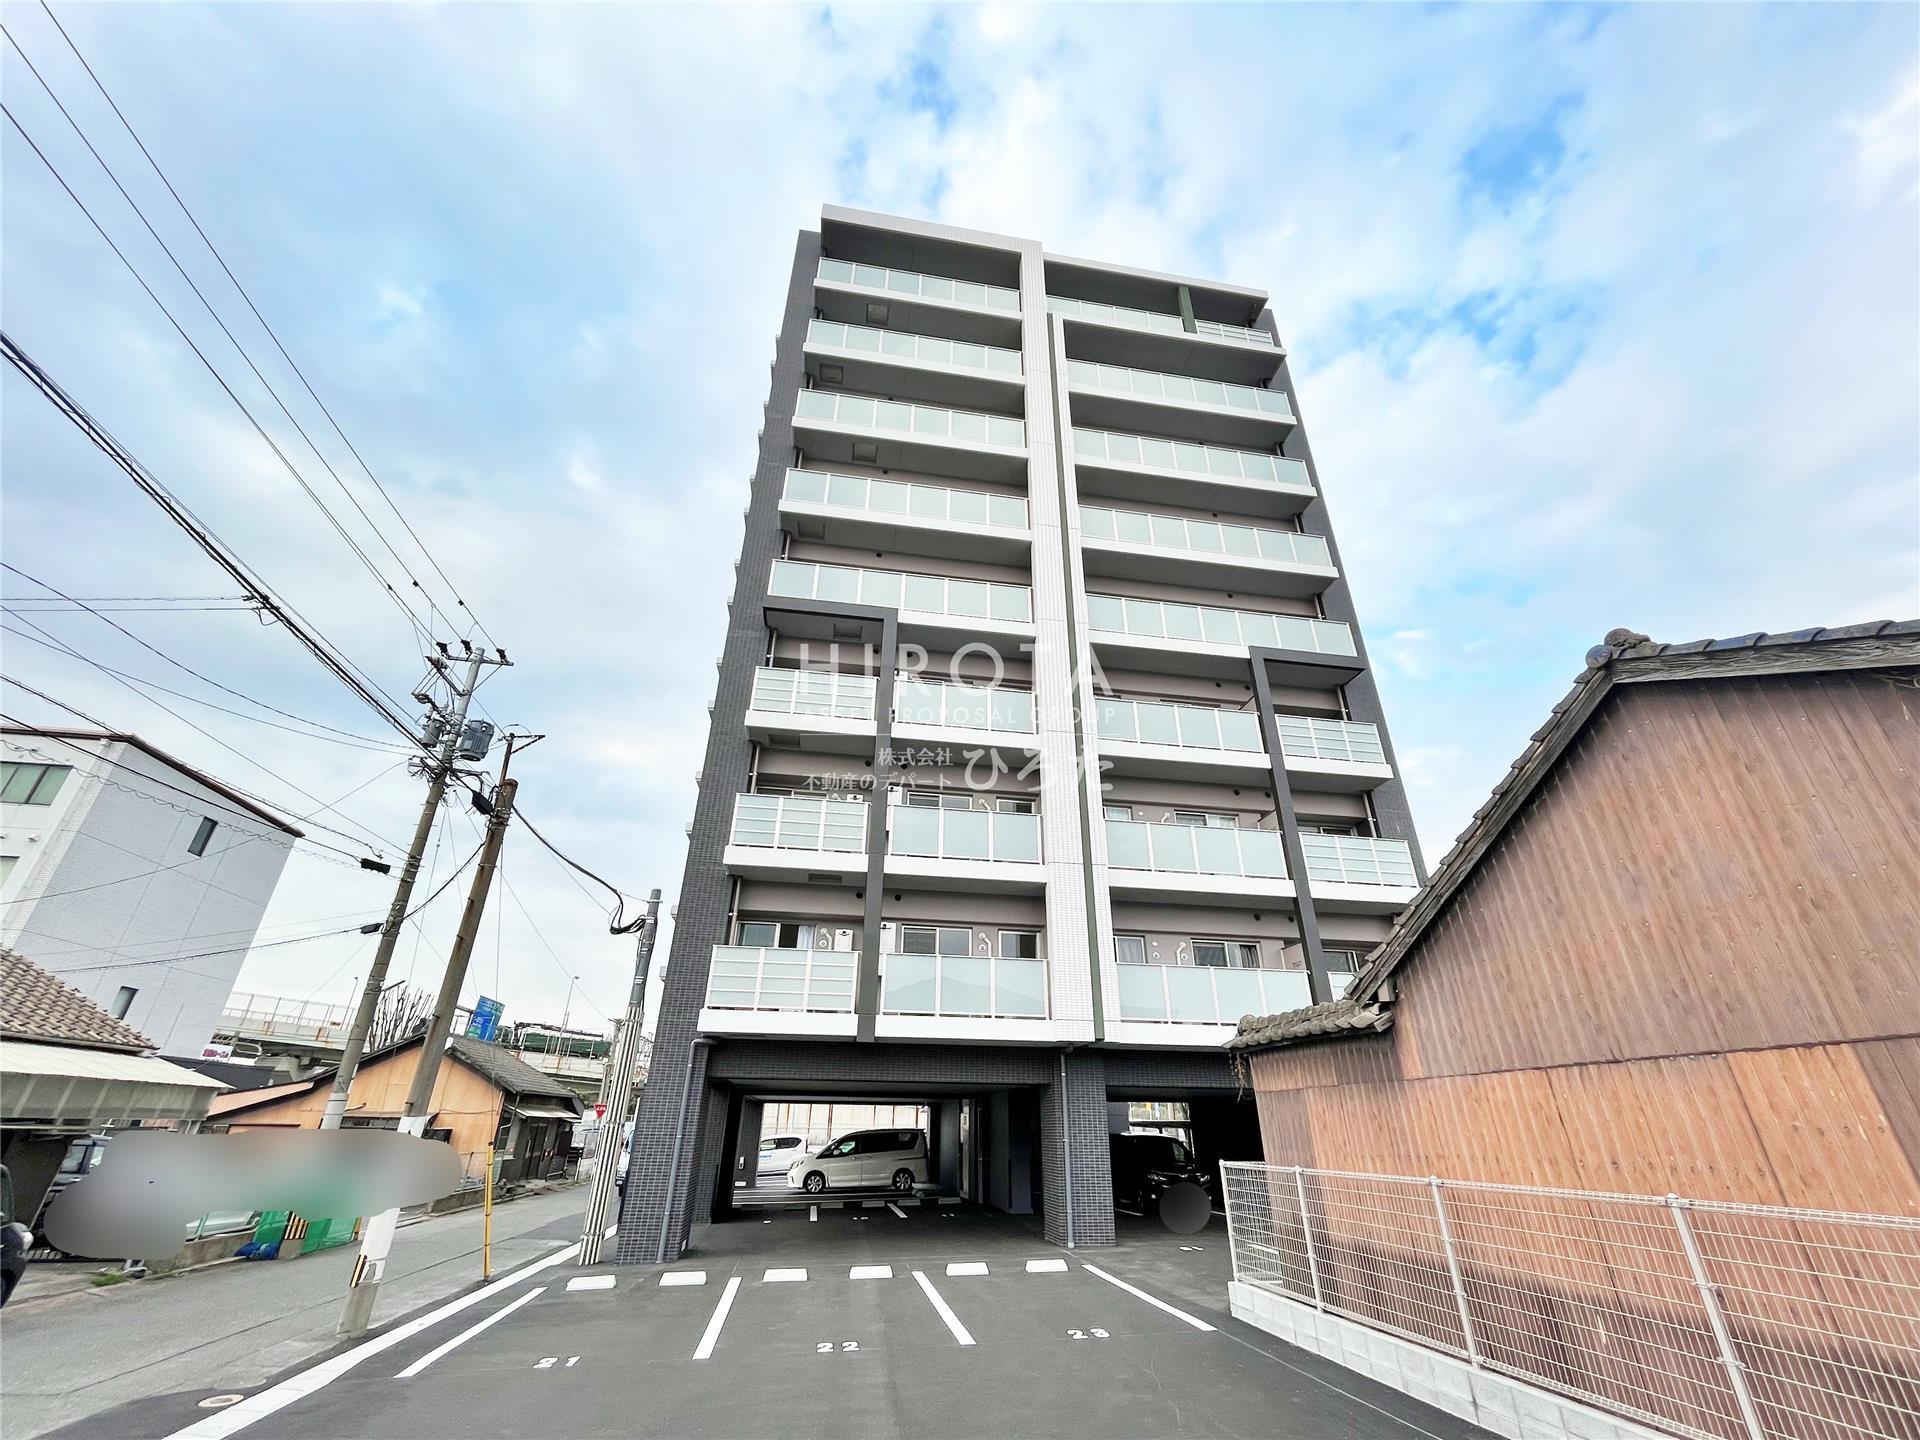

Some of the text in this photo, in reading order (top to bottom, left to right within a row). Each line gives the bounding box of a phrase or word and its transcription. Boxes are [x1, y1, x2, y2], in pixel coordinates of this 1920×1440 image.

[1066, 1328, 1110, 1339] 23
[816, 1341, 860, 1353] 22
[532, 1355, 581, 1369] 21
